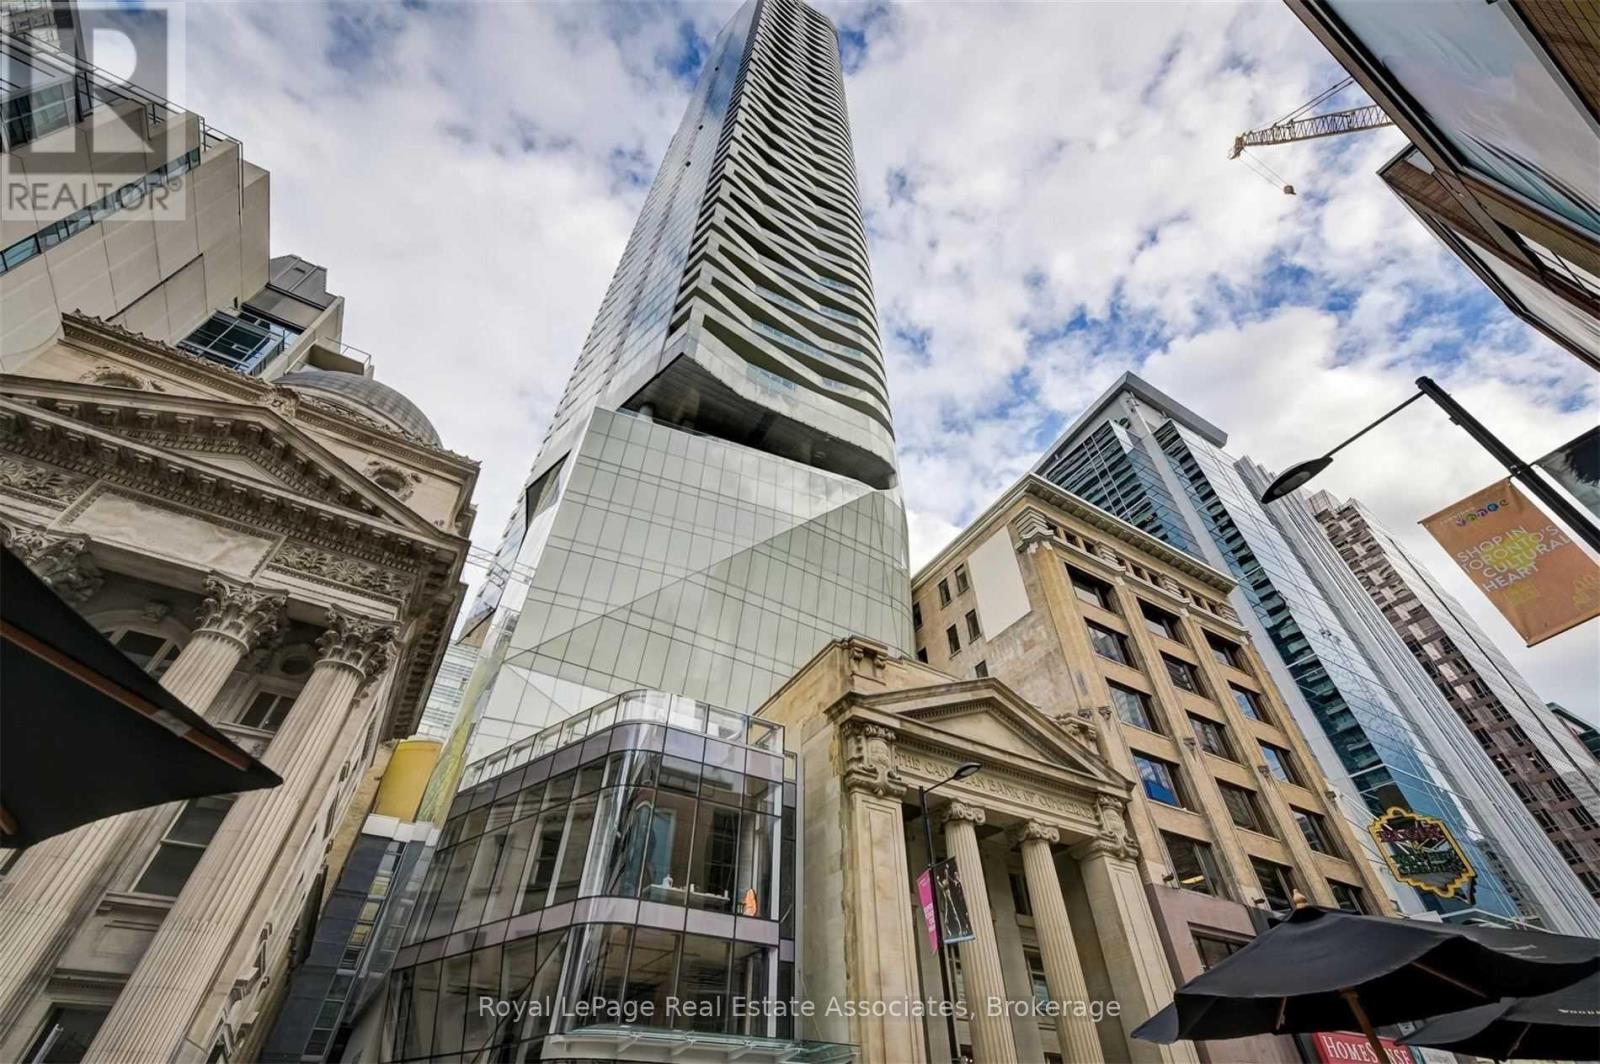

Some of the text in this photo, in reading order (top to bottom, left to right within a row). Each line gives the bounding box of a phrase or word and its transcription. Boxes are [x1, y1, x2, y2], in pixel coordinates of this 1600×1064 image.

[1457, 526, 1528, 561] SHOP IN
[1461, 525, 1561, 573] TORONTO'S
[1482, 535, 1571, 579] CULTURAL
[1482, 562, 1539, 592] HEART
